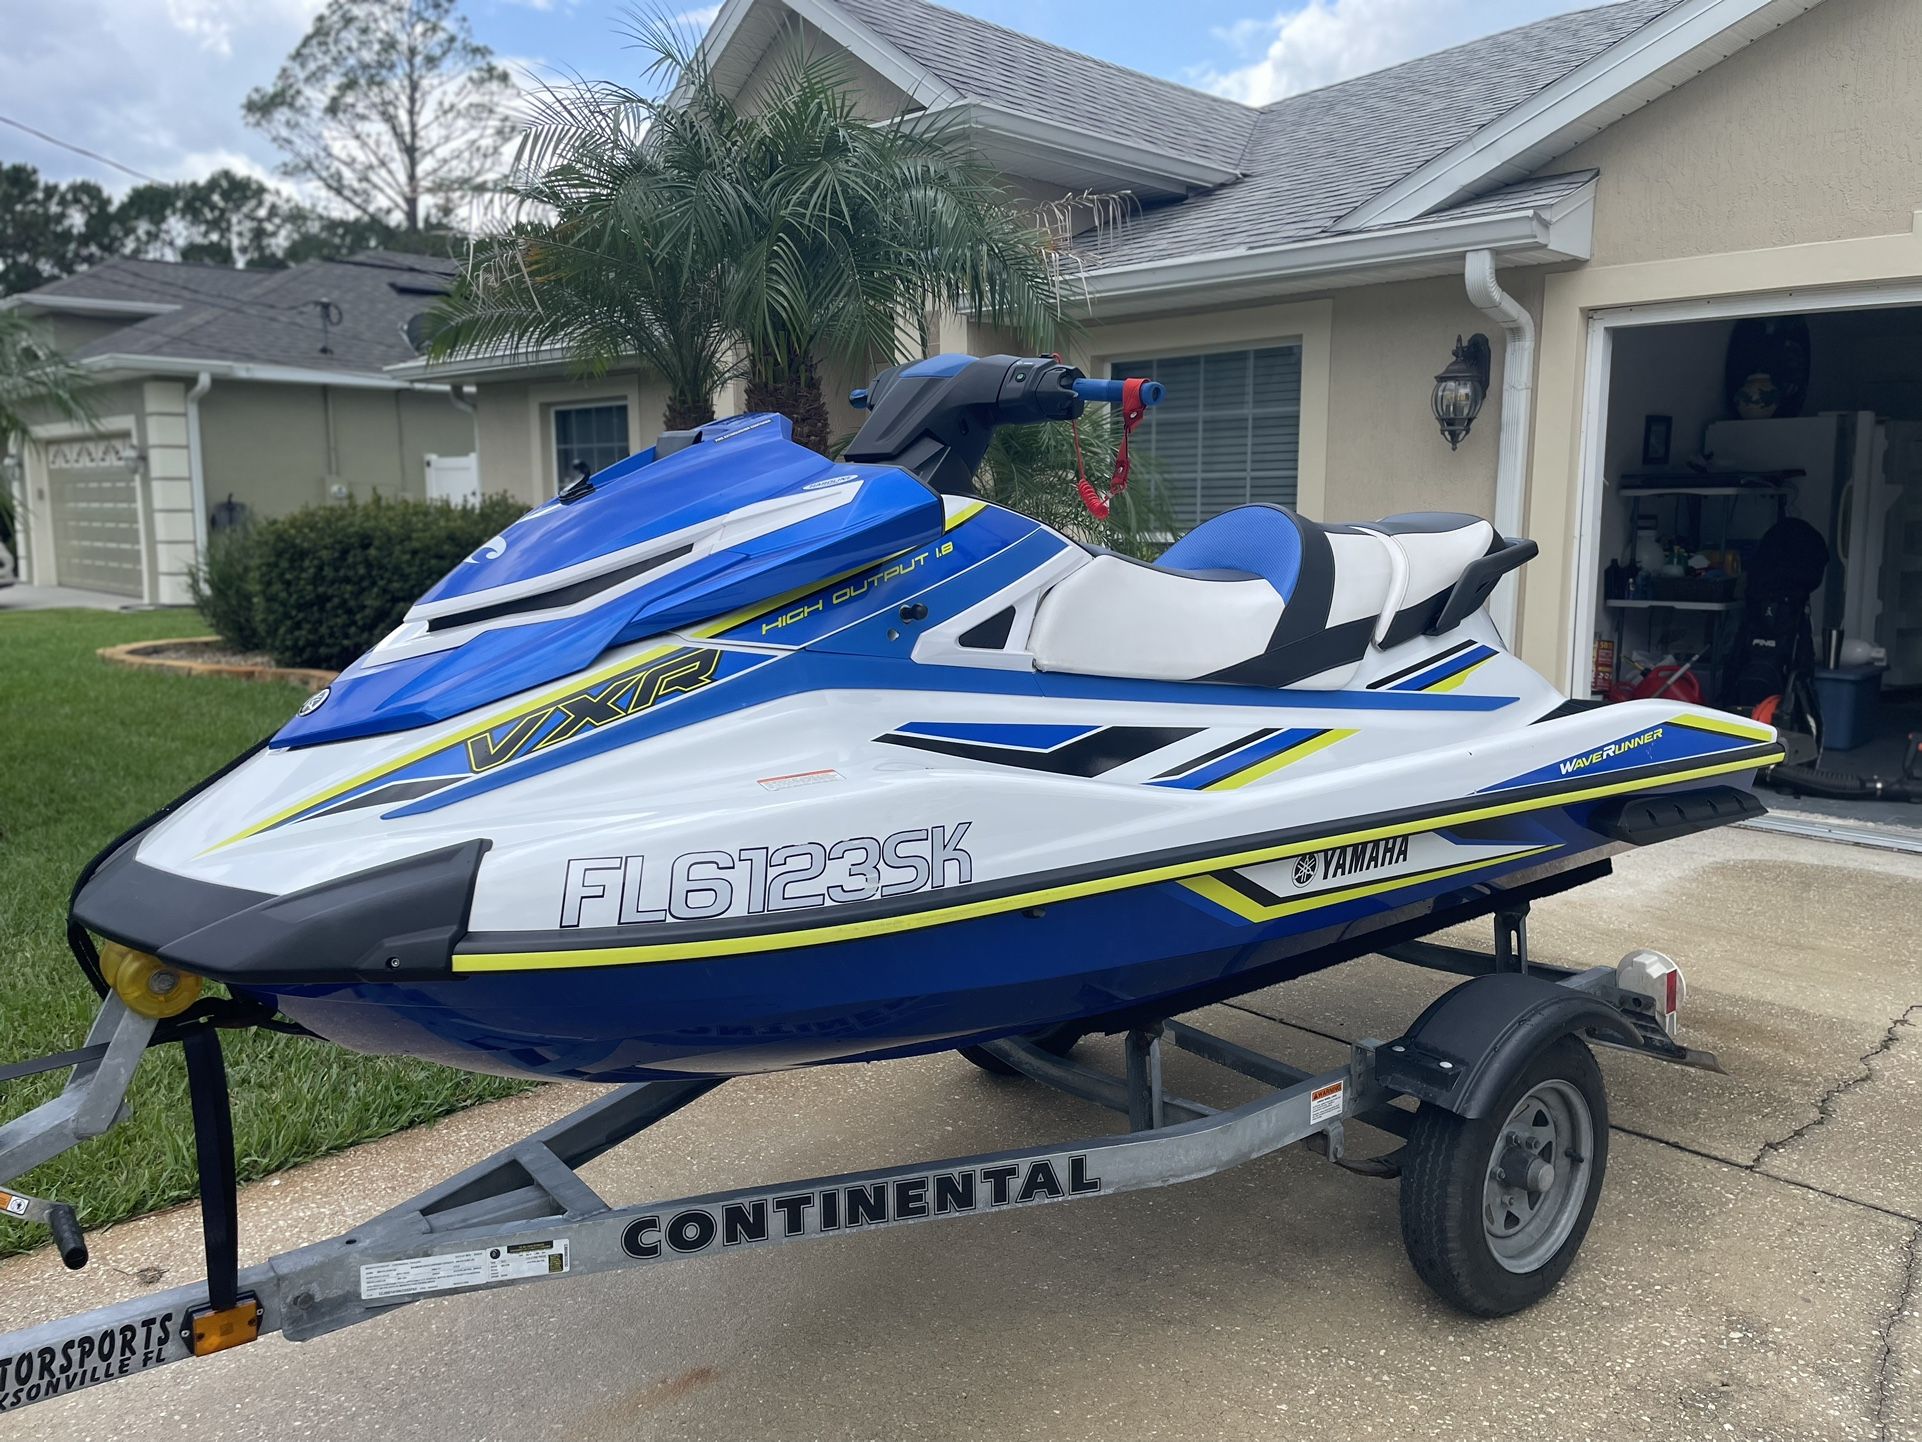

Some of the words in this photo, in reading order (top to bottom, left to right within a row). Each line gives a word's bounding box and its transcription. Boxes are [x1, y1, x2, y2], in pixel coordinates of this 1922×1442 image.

[762, 600, 823, 635] HIGH
[832, 553, 929, 605] OUTPUT
[935, 541, 954, 558] 1.8
[1752, 638, 1776, 648] PING
[467, 647, 721, 772] VXR
[559, 821, 973, 929] FL6123SK
[1321, 835, 1409, 881] YAMAHA
[1317, 1084, 1342, 1098] WARNING
[620, 1154, 1101, 1260] CONTINENTAL
[142, 1347, 166, 1368] FL
